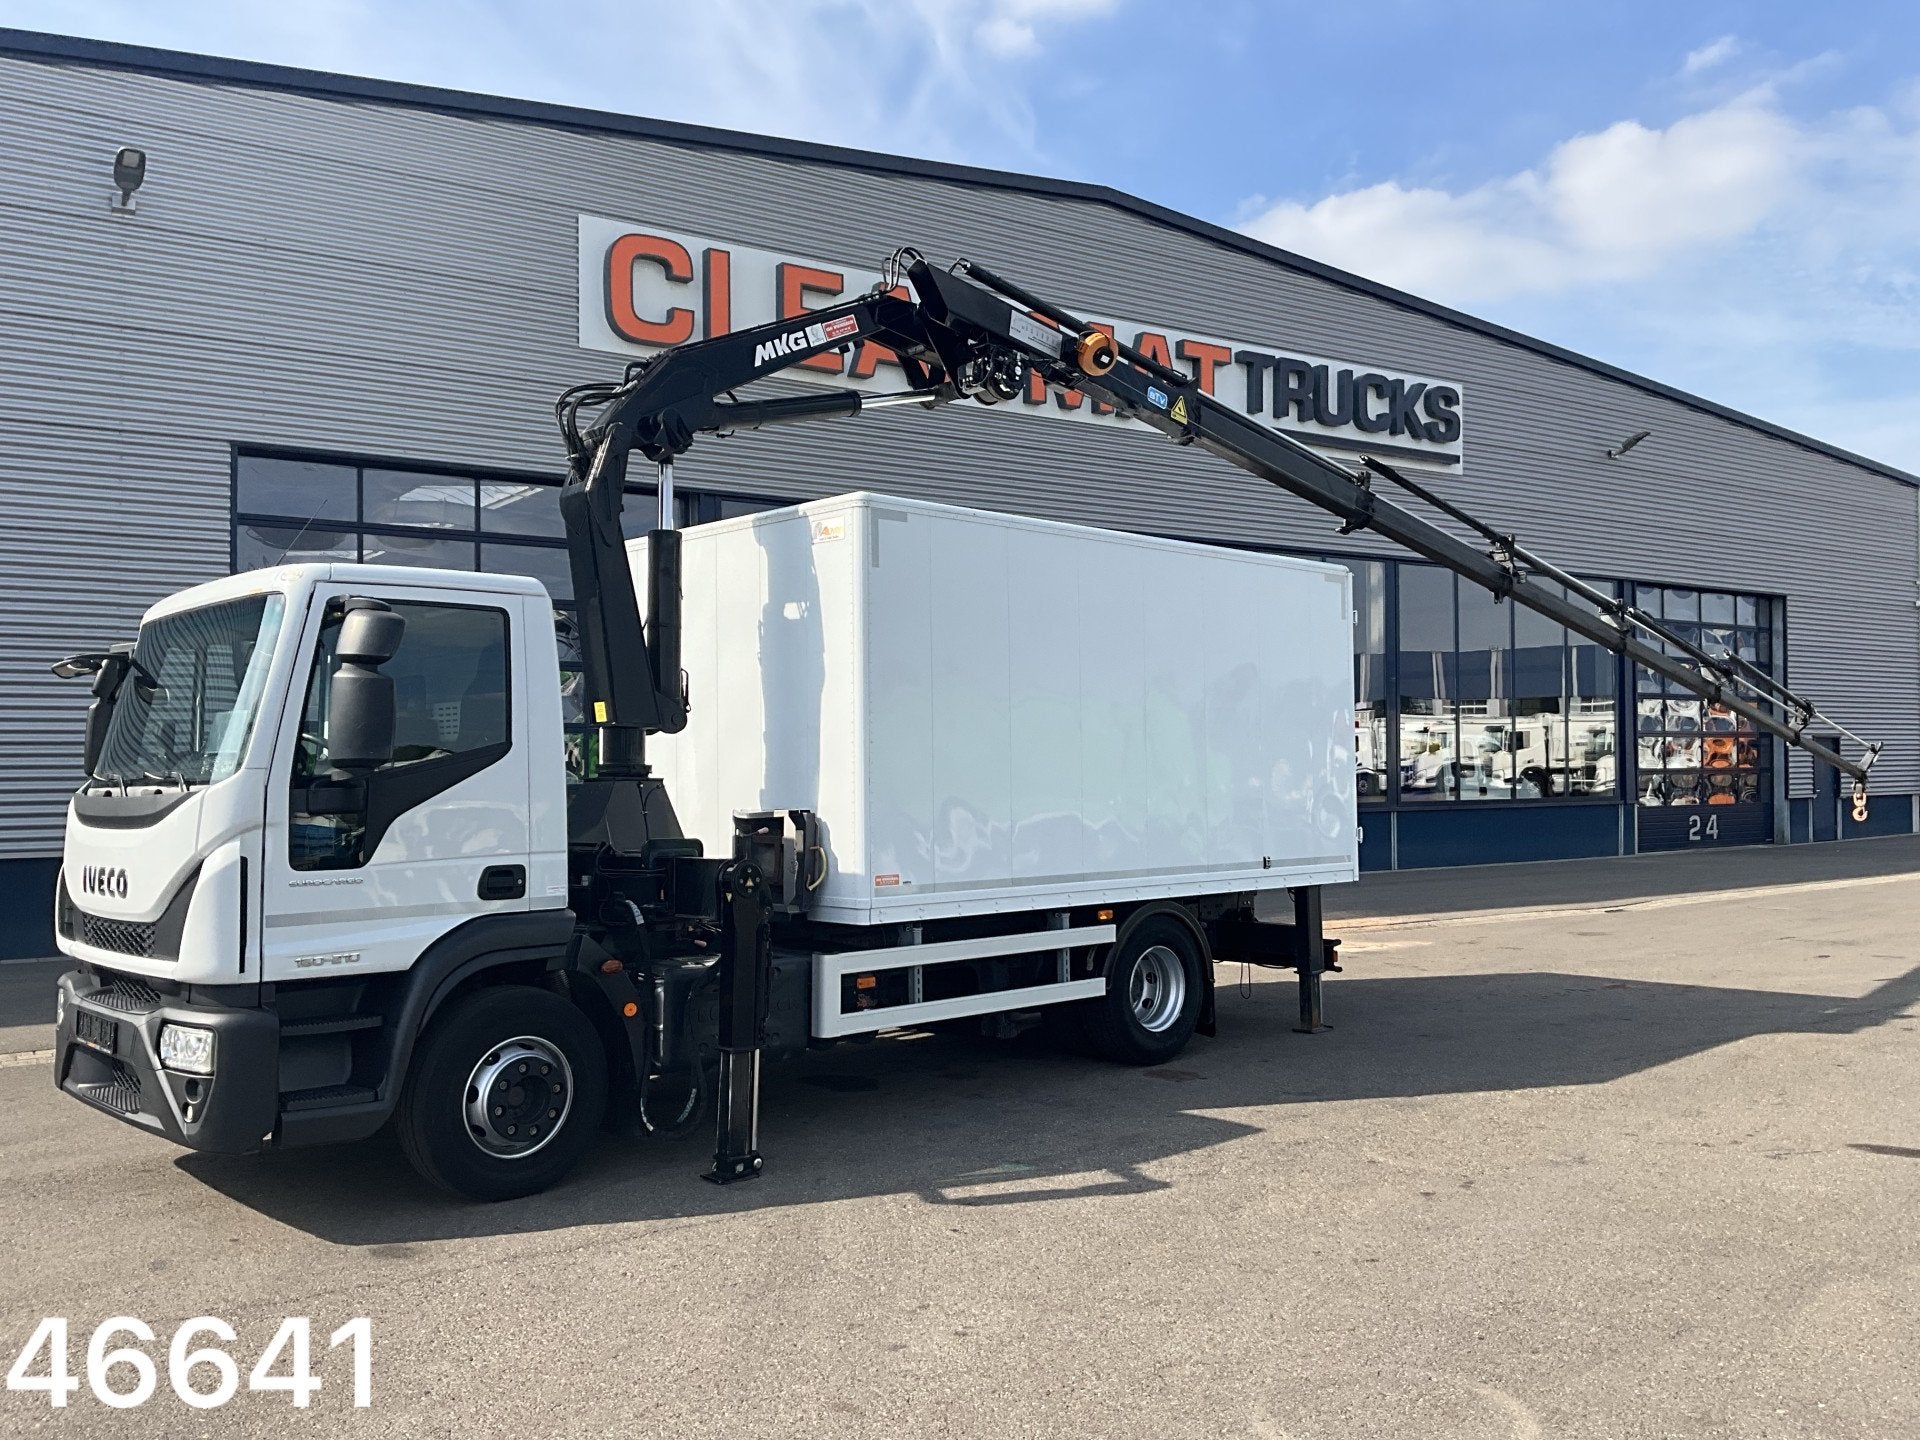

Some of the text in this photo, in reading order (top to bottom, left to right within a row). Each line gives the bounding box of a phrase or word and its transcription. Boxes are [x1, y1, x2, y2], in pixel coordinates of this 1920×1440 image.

[754, 330, 808, 368] MKG
[1234, 350, 1460, 443] TRUCKS
[1689, 814, 1719, 840] 24
[83, 865, 128, 899] IVECO
